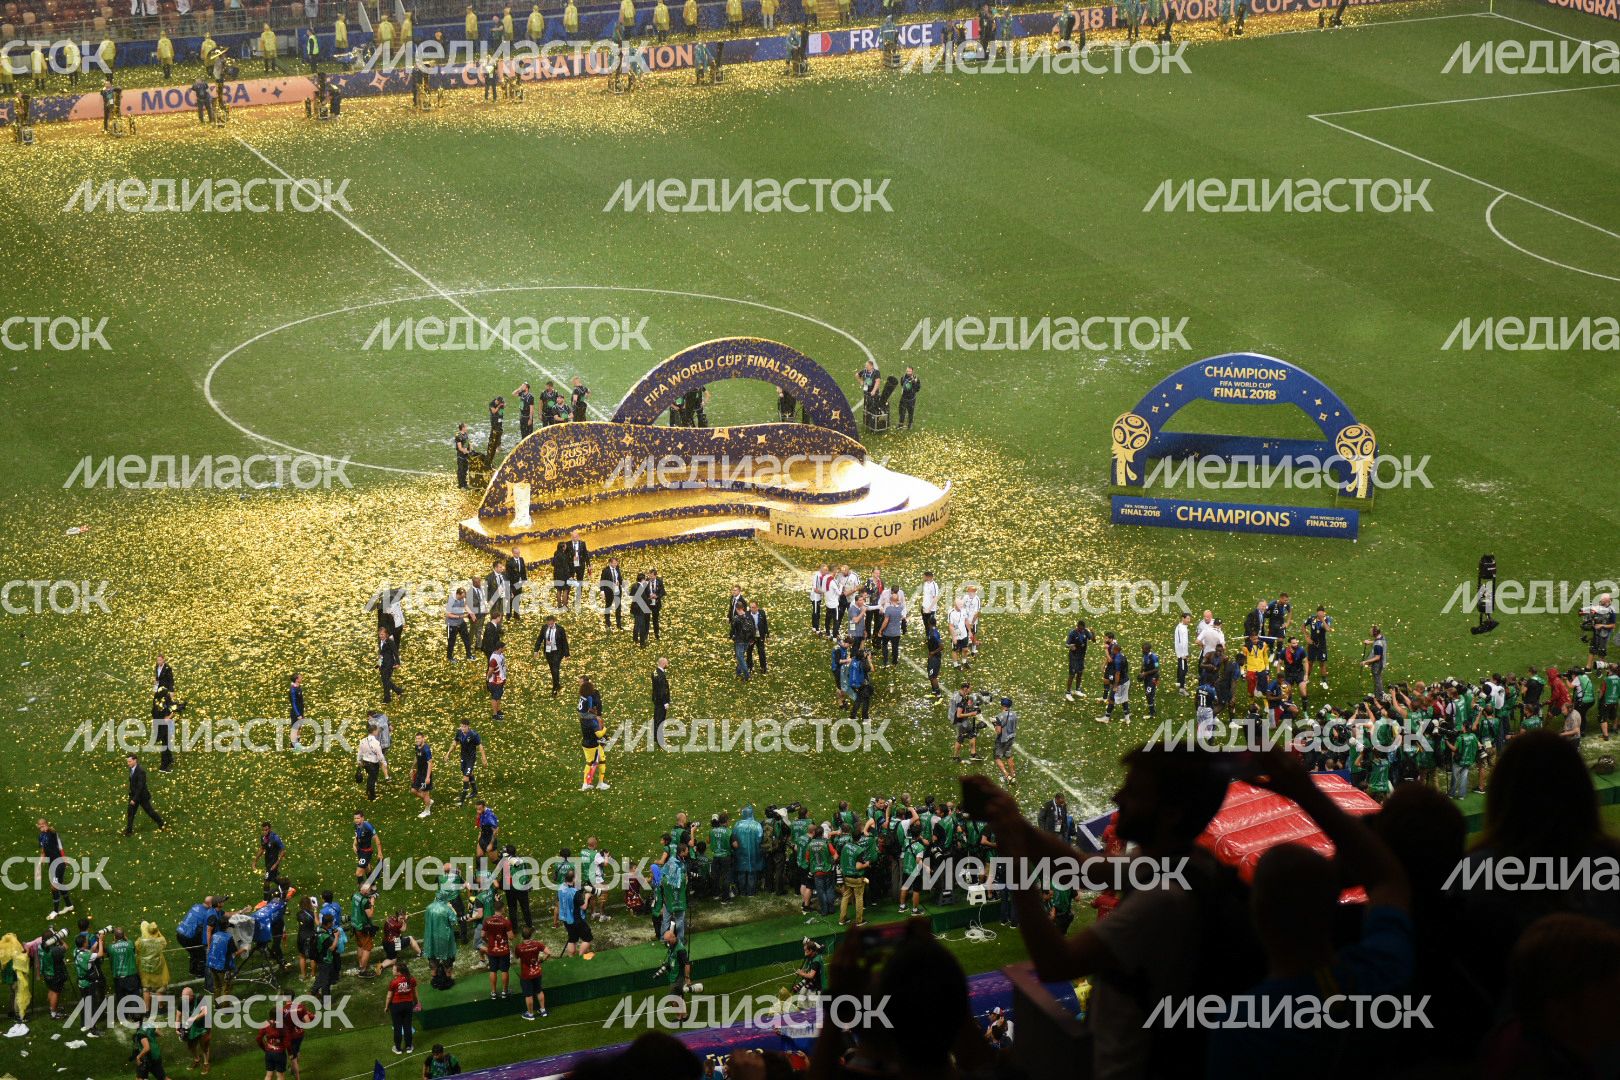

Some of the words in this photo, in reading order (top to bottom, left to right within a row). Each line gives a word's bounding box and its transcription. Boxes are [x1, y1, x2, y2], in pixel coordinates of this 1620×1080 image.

[1162, 0, 1236, 20] WOR
[462, 44, 696, 86] CNGRATUION
[141, 83, 250, 111] МОСВА
[643, 383, 669, 407] FIFA
[667, 359, 715, 386] WORLD
[716, 354, 743, 368] CUP
[746, 354, 780, 373] FINAL
[781, 365, 808, 388] 2018
[1204, 365, 1287, 381] CHAMPIONS
[1213, 387, 1248, 399] FINAL
[1249, 389, 1277, 400] 2018
[1120, 508, 1143, 516] FINAL
[1143, 509, 1161, 517] 2018
[1176, 505, 1291, 528] CHAMPIONS
[776, 522, 806, 539] FIFA
[810, 527, 869, 541] WORLD
[873, 522, 902, 538] CUP
[912, 510, 940, 531] FINAL
[1306, 519, 1329, 527] FINAL
[1330, 520, 1347, 529] 2018
